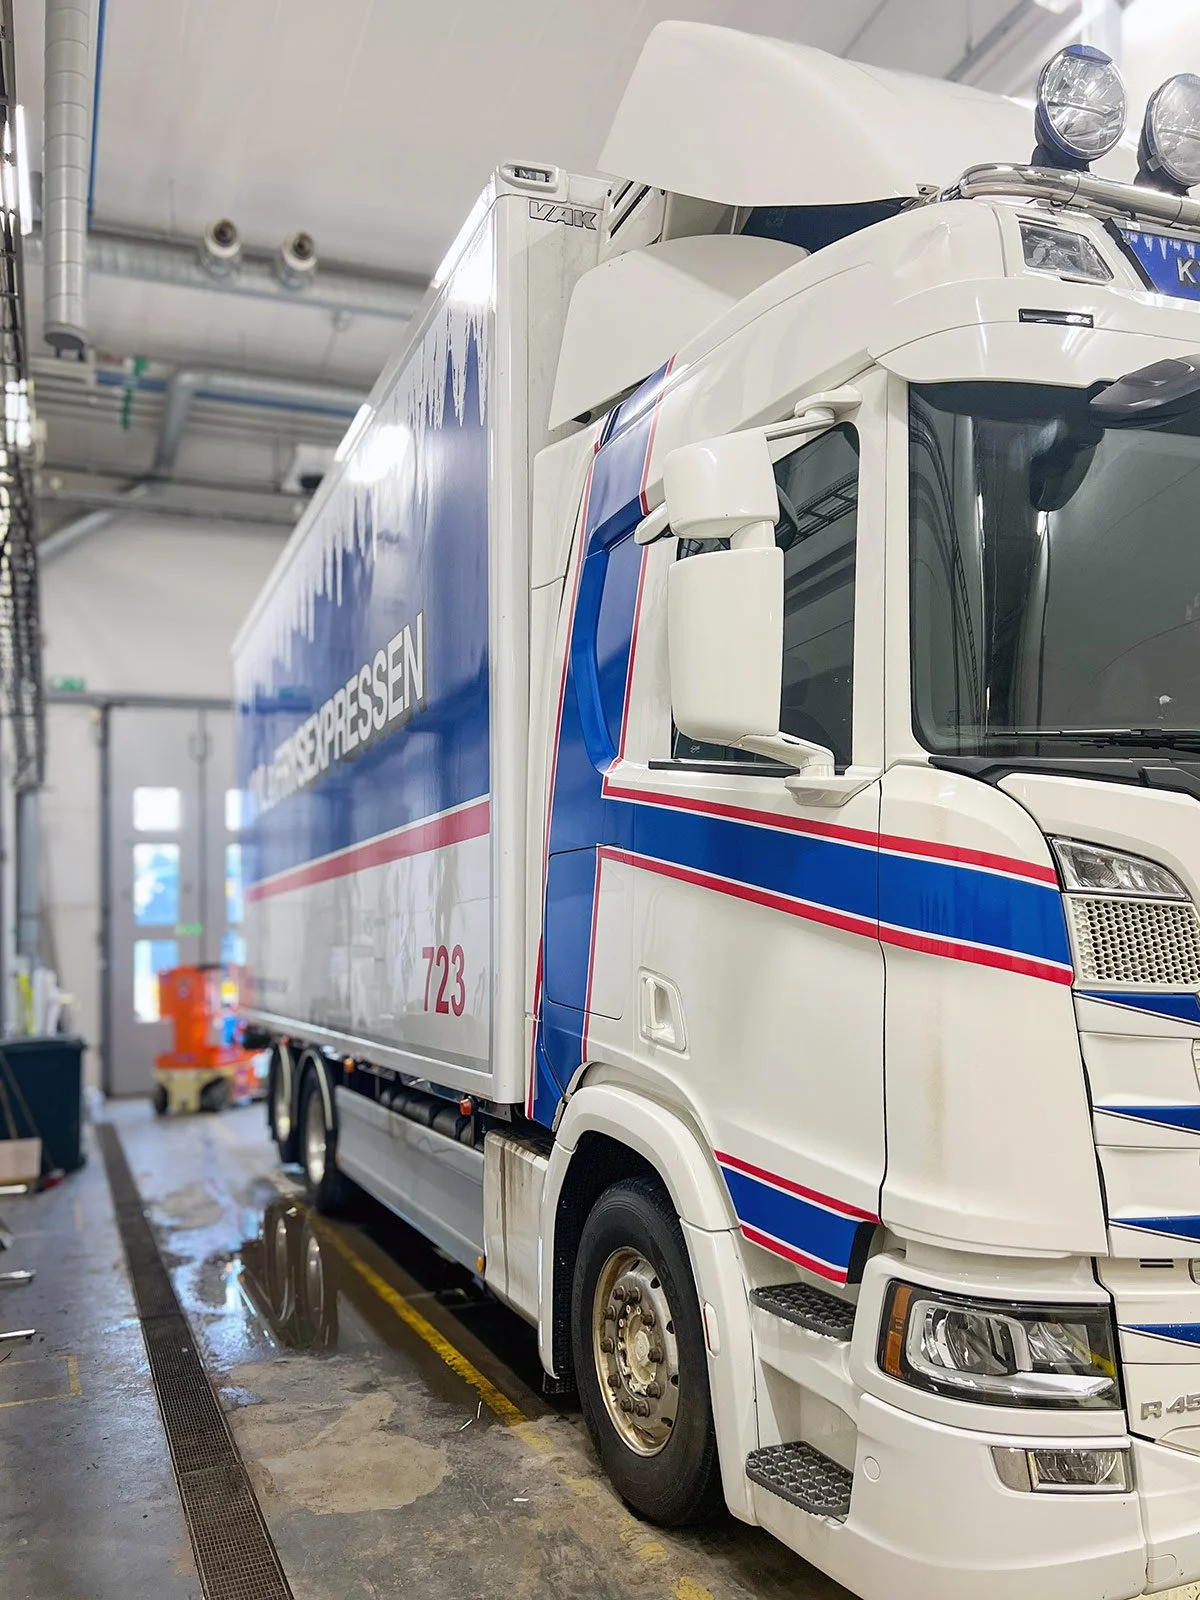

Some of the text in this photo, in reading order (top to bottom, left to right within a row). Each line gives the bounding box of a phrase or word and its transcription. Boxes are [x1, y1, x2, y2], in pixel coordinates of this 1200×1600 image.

[529, 200, 597, 230] VAK
[1177, 256, 1200, 284] K
[274, 611, 424, 797] SEXPRESSEN
[422, 944, 466, 1017] 723
[1140, 1400, 1163, 1420] R
